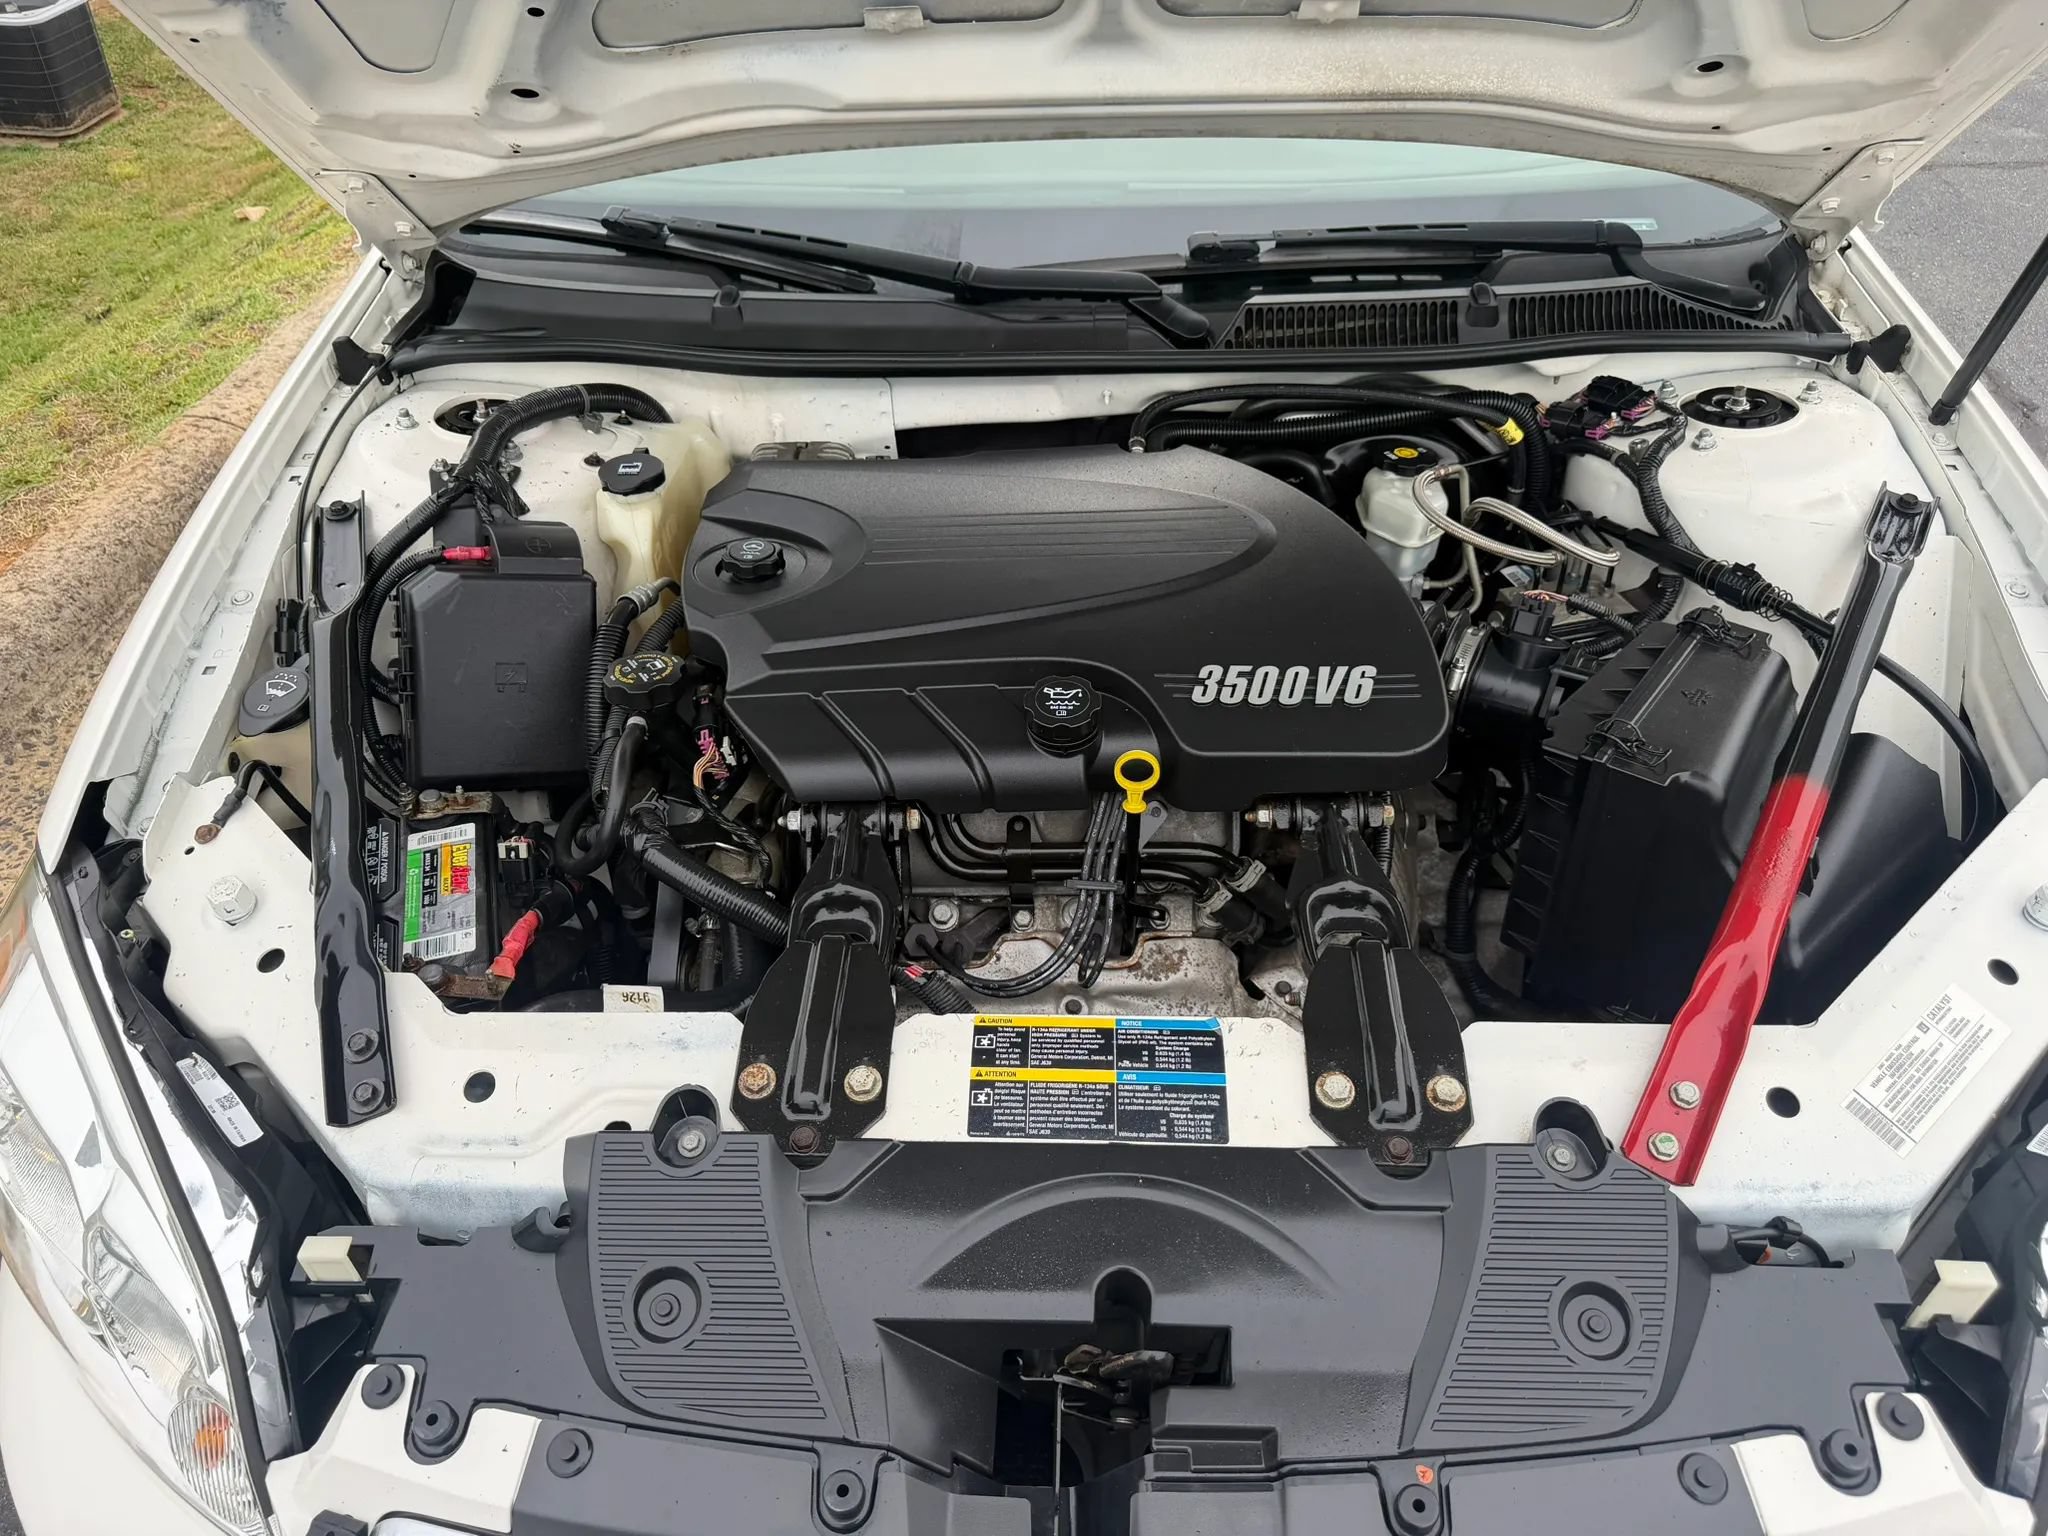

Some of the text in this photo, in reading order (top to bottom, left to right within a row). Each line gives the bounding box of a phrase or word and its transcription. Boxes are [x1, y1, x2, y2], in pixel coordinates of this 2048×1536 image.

[1191, 664, 1377, 705] 3500 V6
[380, 862, 388, 882] POISON
[1926, 993, 1952, 1021] CATALYST
[1869, 1034, 1920, 1088] VEHICLE EMISSION CONTROL
[1888, 1050, 1914, 1079] INFORMATION
